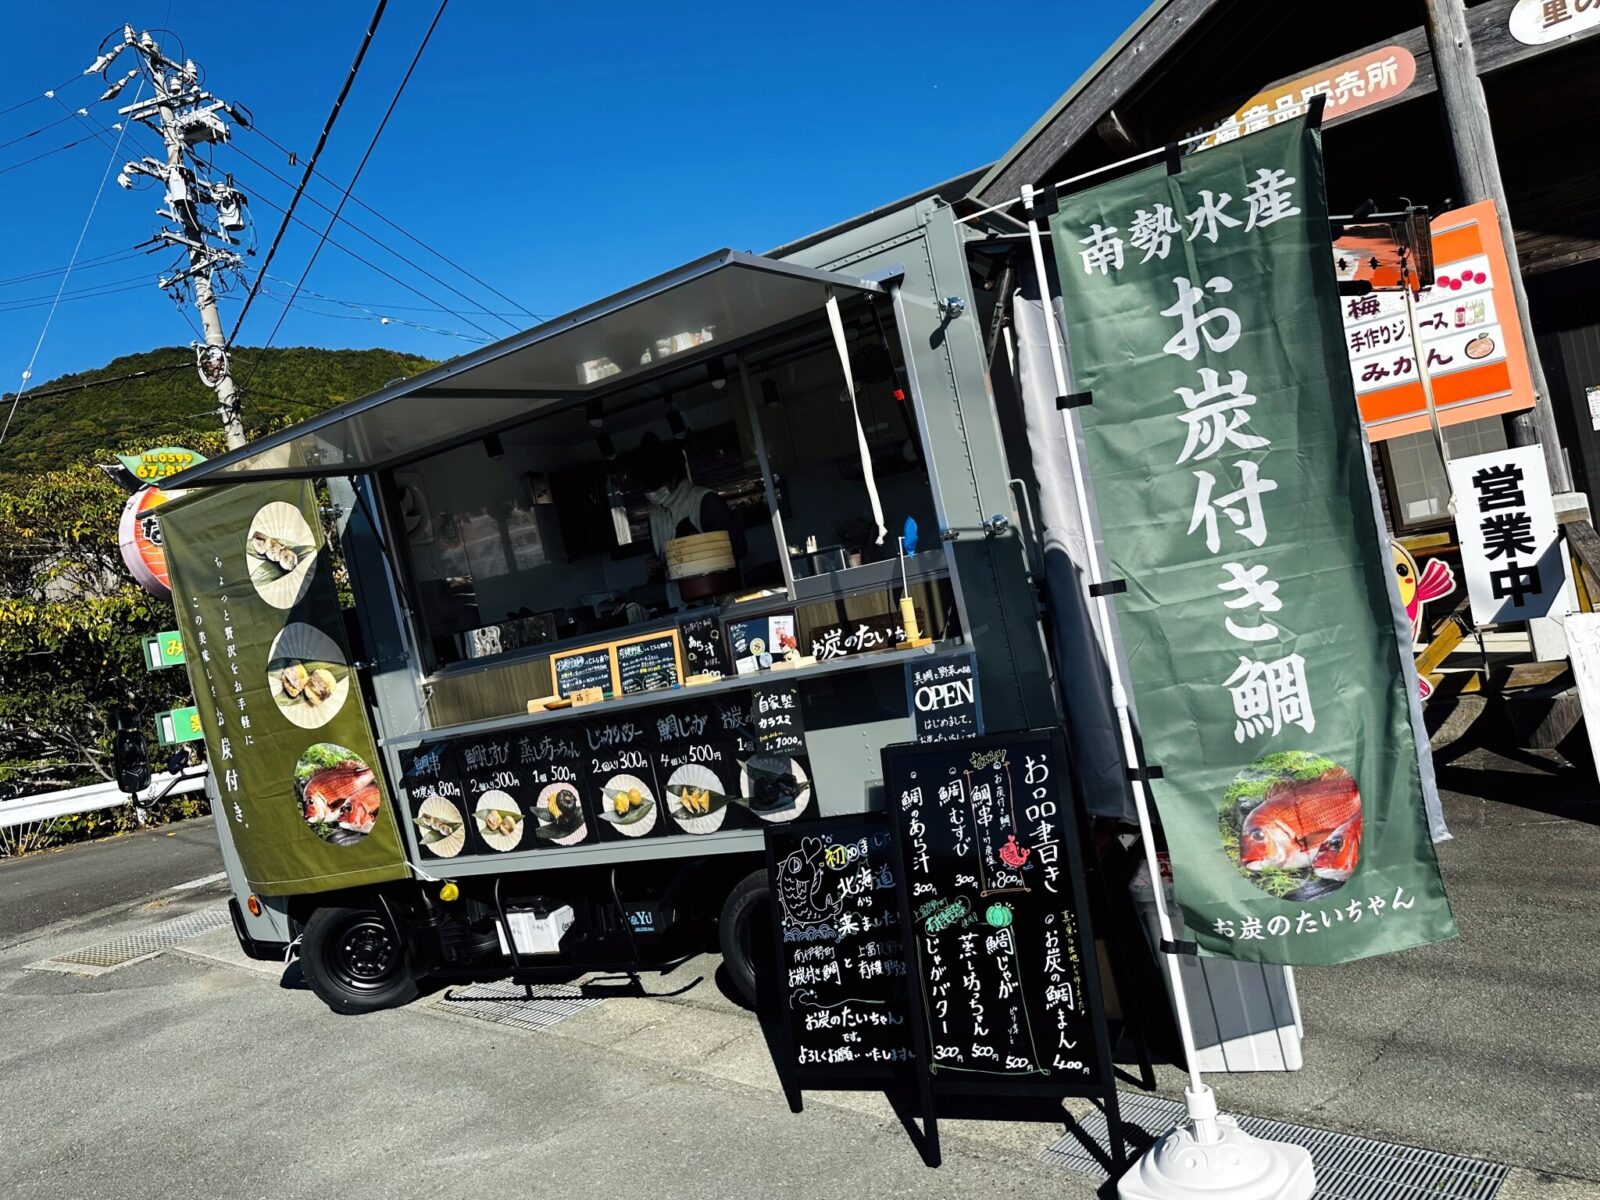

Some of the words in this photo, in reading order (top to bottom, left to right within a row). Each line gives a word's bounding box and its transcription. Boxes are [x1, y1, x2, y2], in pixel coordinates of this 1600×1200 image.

[1186, 55, 1400, 154] 場産品販売所
[1077, 167, 1302, 277] 南勢水産
[1350, 311, 1449, 353] 手作りジース
[1361, 348, 1454, 382] みかん
[1159, 275, 1317, 745] お炭付き鯛
[1472, 463, 1543, 607] 営業中
[213, 555, 255, 746] ちょっと贅沢をお手軽に
[687, 635, 715, 658] あら汁
[811, 623, 924, 660] お炭のたいち
[758, 694, 797, 713] 自家製
[915, 678, 975, 711] OPEN
[656, 713, 709, 743] 鯛じゃが
[720, 705, 757, 730] お炭の
[758, 714, 792, 730] カラスミ
[586, 722, 644, 750] じゃがバター
[412, 752, 442, 778] 鯛串
[464, 742, 511, 773] 鯛むすび
[936, 778, 972, 857] 鯛むすび
[972, 782, 994, 827] 鯛串
[901, 785, 931, 874] 鯛のあら汁
[1023, 753, 1061, 894] お品書き
[836, 863, 897, 900] 北海道
[912, 882, 938, 897] 300円
[954, 873, 979, 890] 300円
[1212, 886, 1416, 941] お炭のたいちゃん
[843, 957, 854, 969] と
[985, 927, 1020, 1000] 鯛じゃが
[925, 938, 951, 1035] じゃがバター
[957, 932, 989, 1037] 蒸し坊っちゃん
[1043, 929, 1078, 1050] お炭の鯛まん
[804, 1005, 904, 1031] お炭のたいちゃん
[934, 1044, 964, 1063] 300円
[971, 1042, 999, 1062] 500円
[1005, 1055, 1034, 1072] 500円
[1052, 1053, 1091, 1076] 400円
